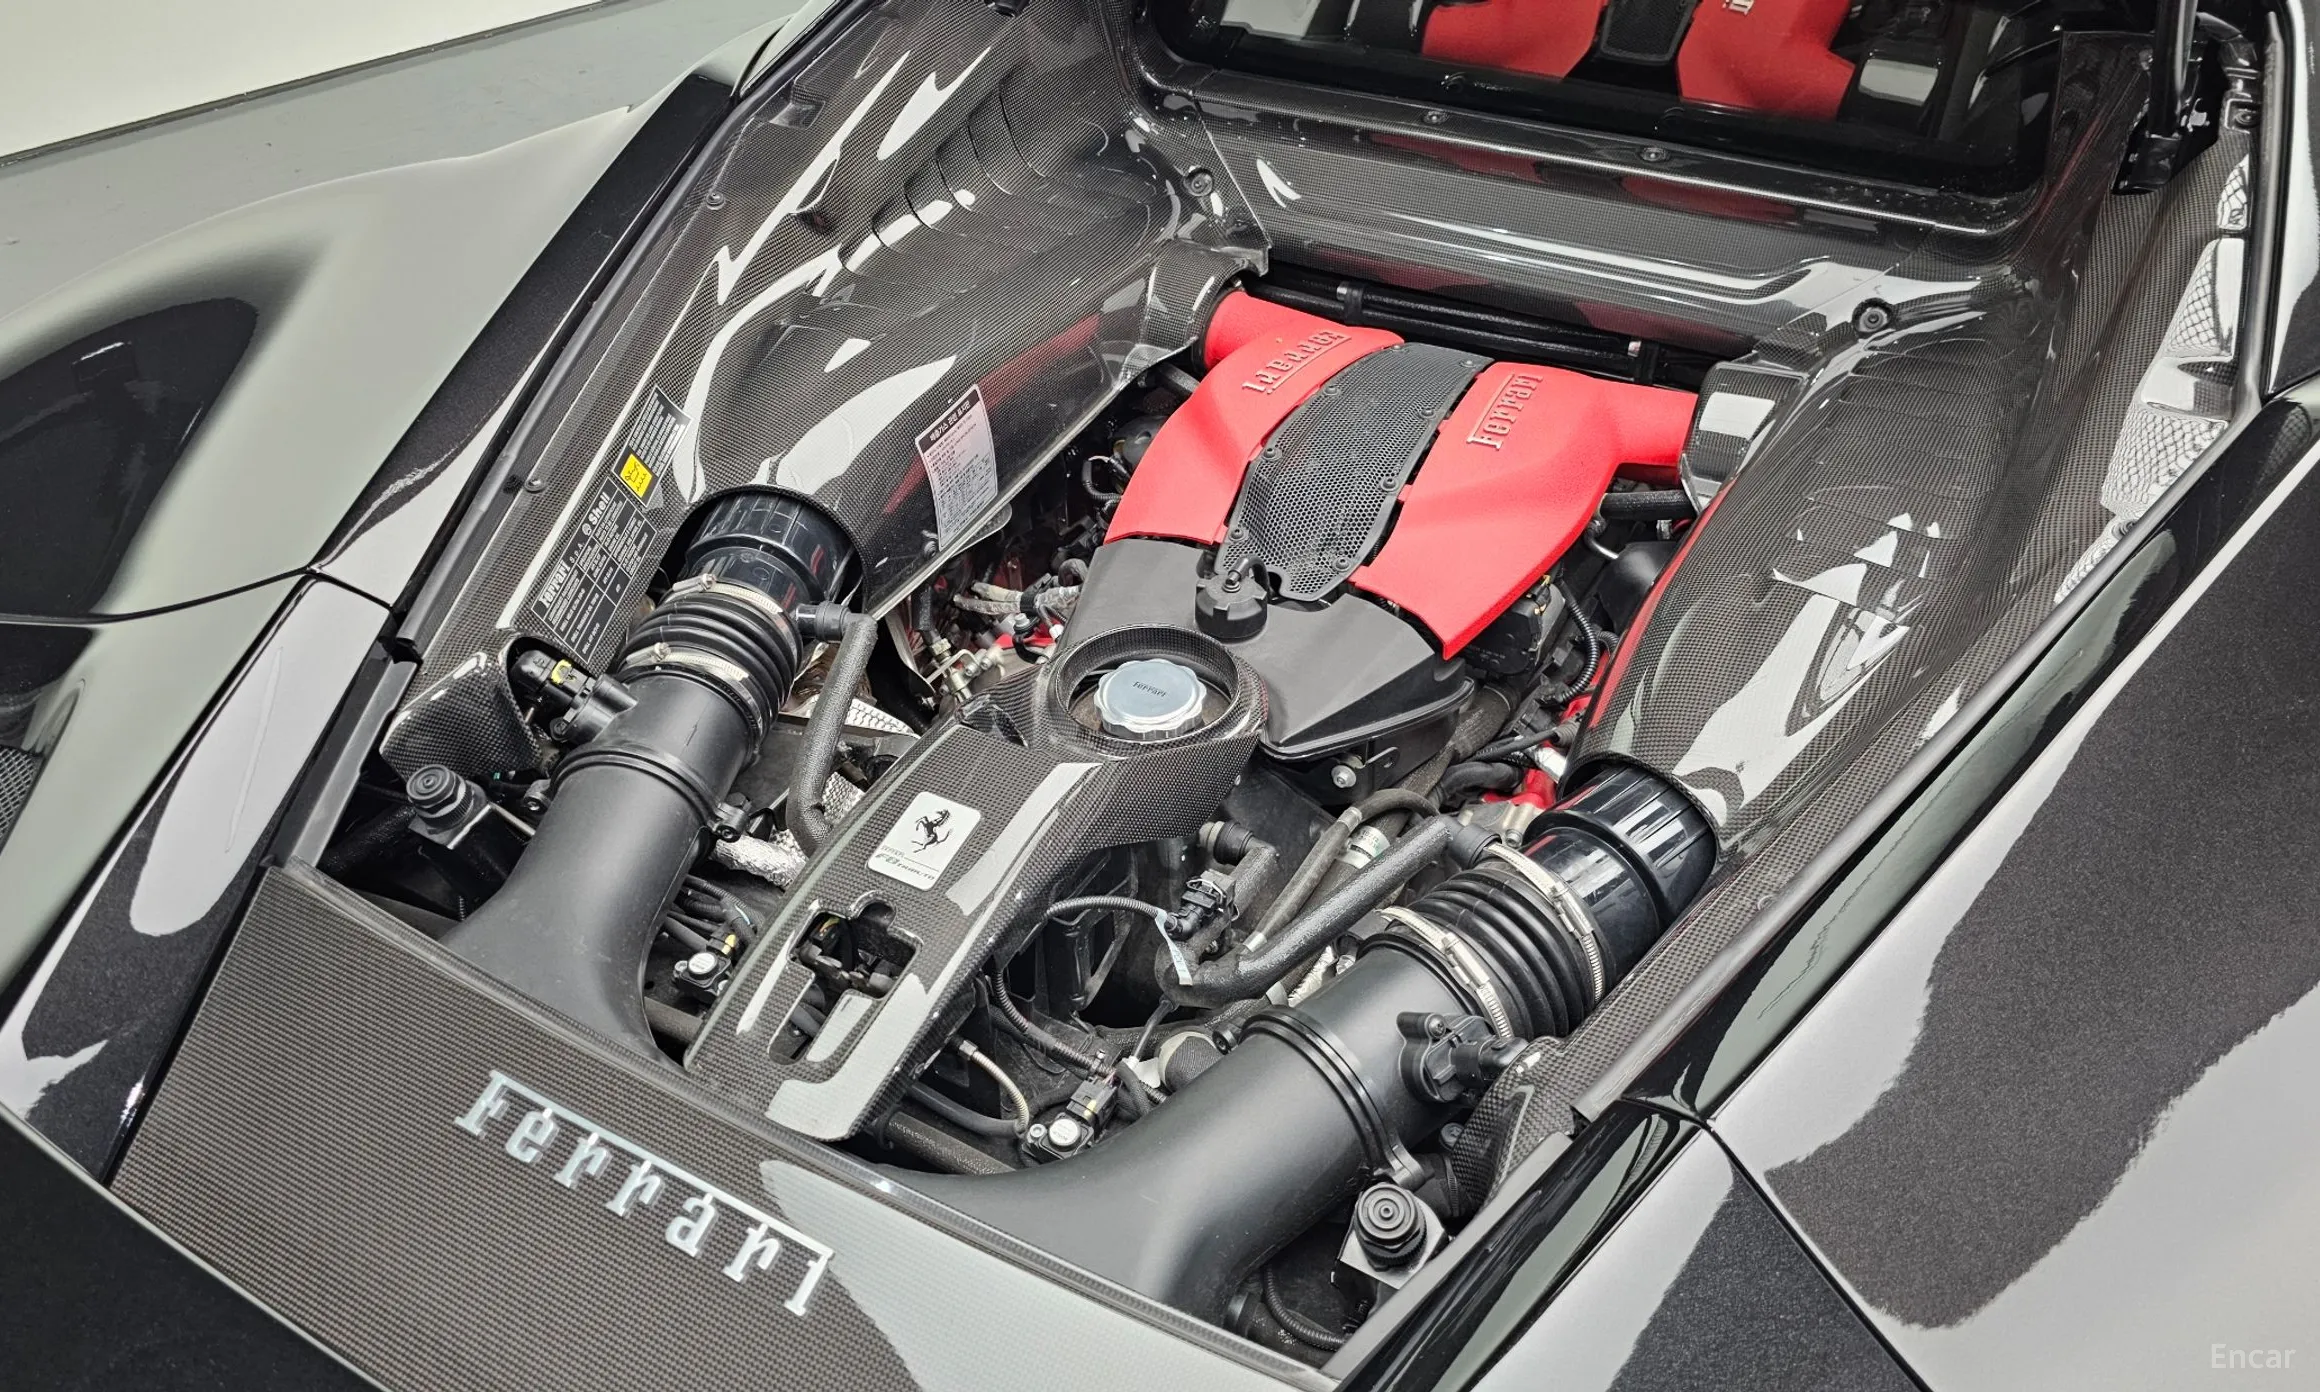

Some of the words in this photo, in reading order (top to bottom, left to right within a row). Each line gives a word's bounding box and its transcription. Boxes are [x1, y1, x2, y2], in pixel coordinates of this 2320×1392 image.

[1466, 373, 1543, 450] Ferrari
[588, 491, 610, 526] Shell
[538, 560, 570, 608] Ferrari
[453, 1069, 834, 1317] Ferrari
